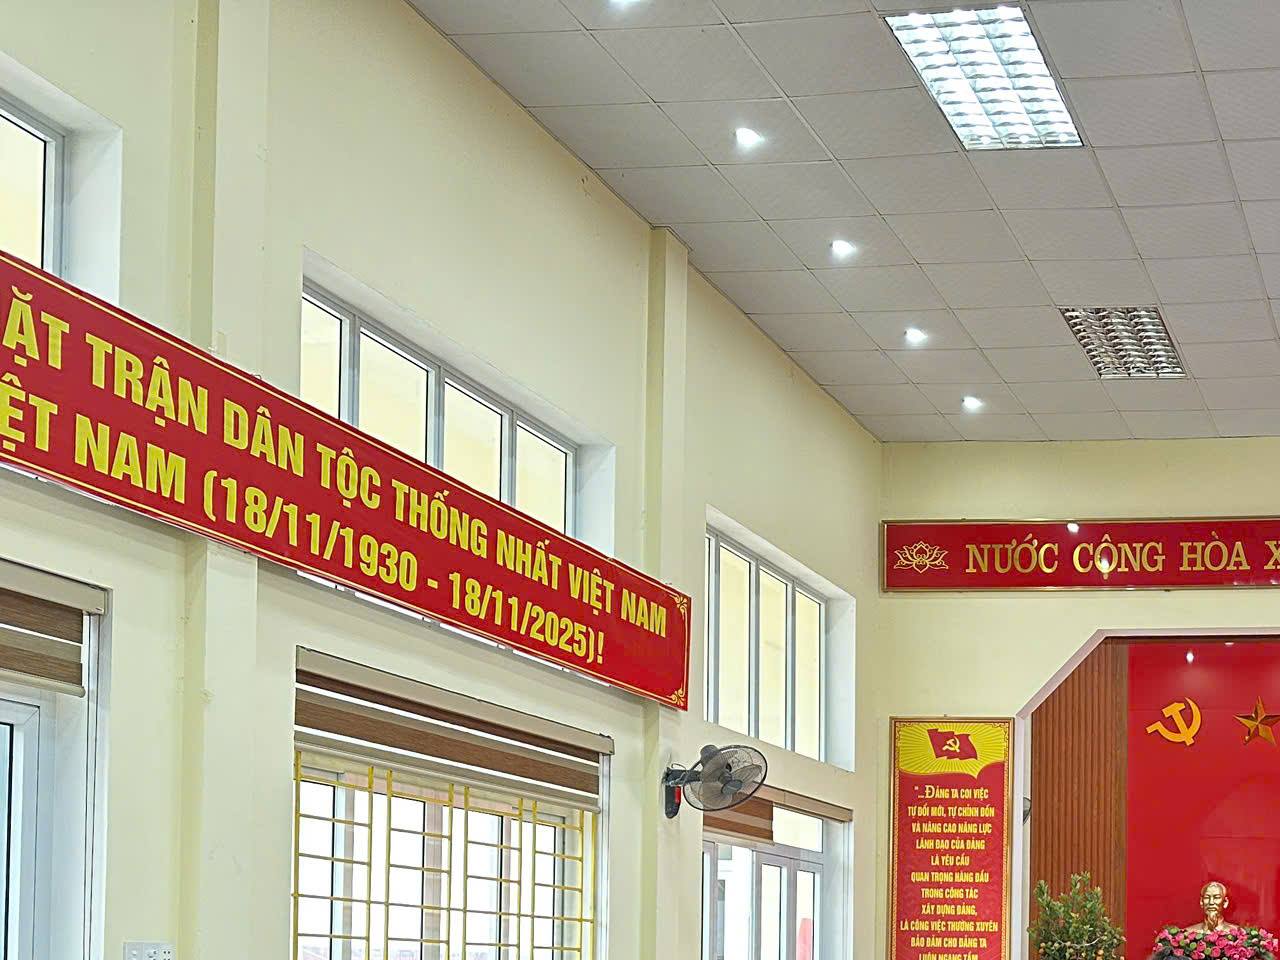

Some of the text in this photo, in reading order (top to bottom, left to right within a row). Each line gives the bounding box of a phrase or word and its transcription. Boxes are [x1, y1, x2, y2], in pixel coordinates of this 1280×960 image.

[74, 415, 186, 504] NAM
[203, 469, 419, 592] (18/11/1930
[449, 571, 605, 665] 18/11/2025)!
[85, 332, 208, 434] TRẬN
[223, 397, 305, 477] DÂN
[316, 441, 381, 510] TỘC
[392, 480, 488, 557] THỐNG
[496, 535, 562, 589] NHẤT
[568, 565, 616, 616] VIỆT
[620, 586, 668, 638] NAM
[965, 533, 1059, 574] NƯỚC
[1073, 533, 1166, 578] CỘNG
[1179, 530, 1250, 571] HÒA
[943, 823, 957, 833] CAO
